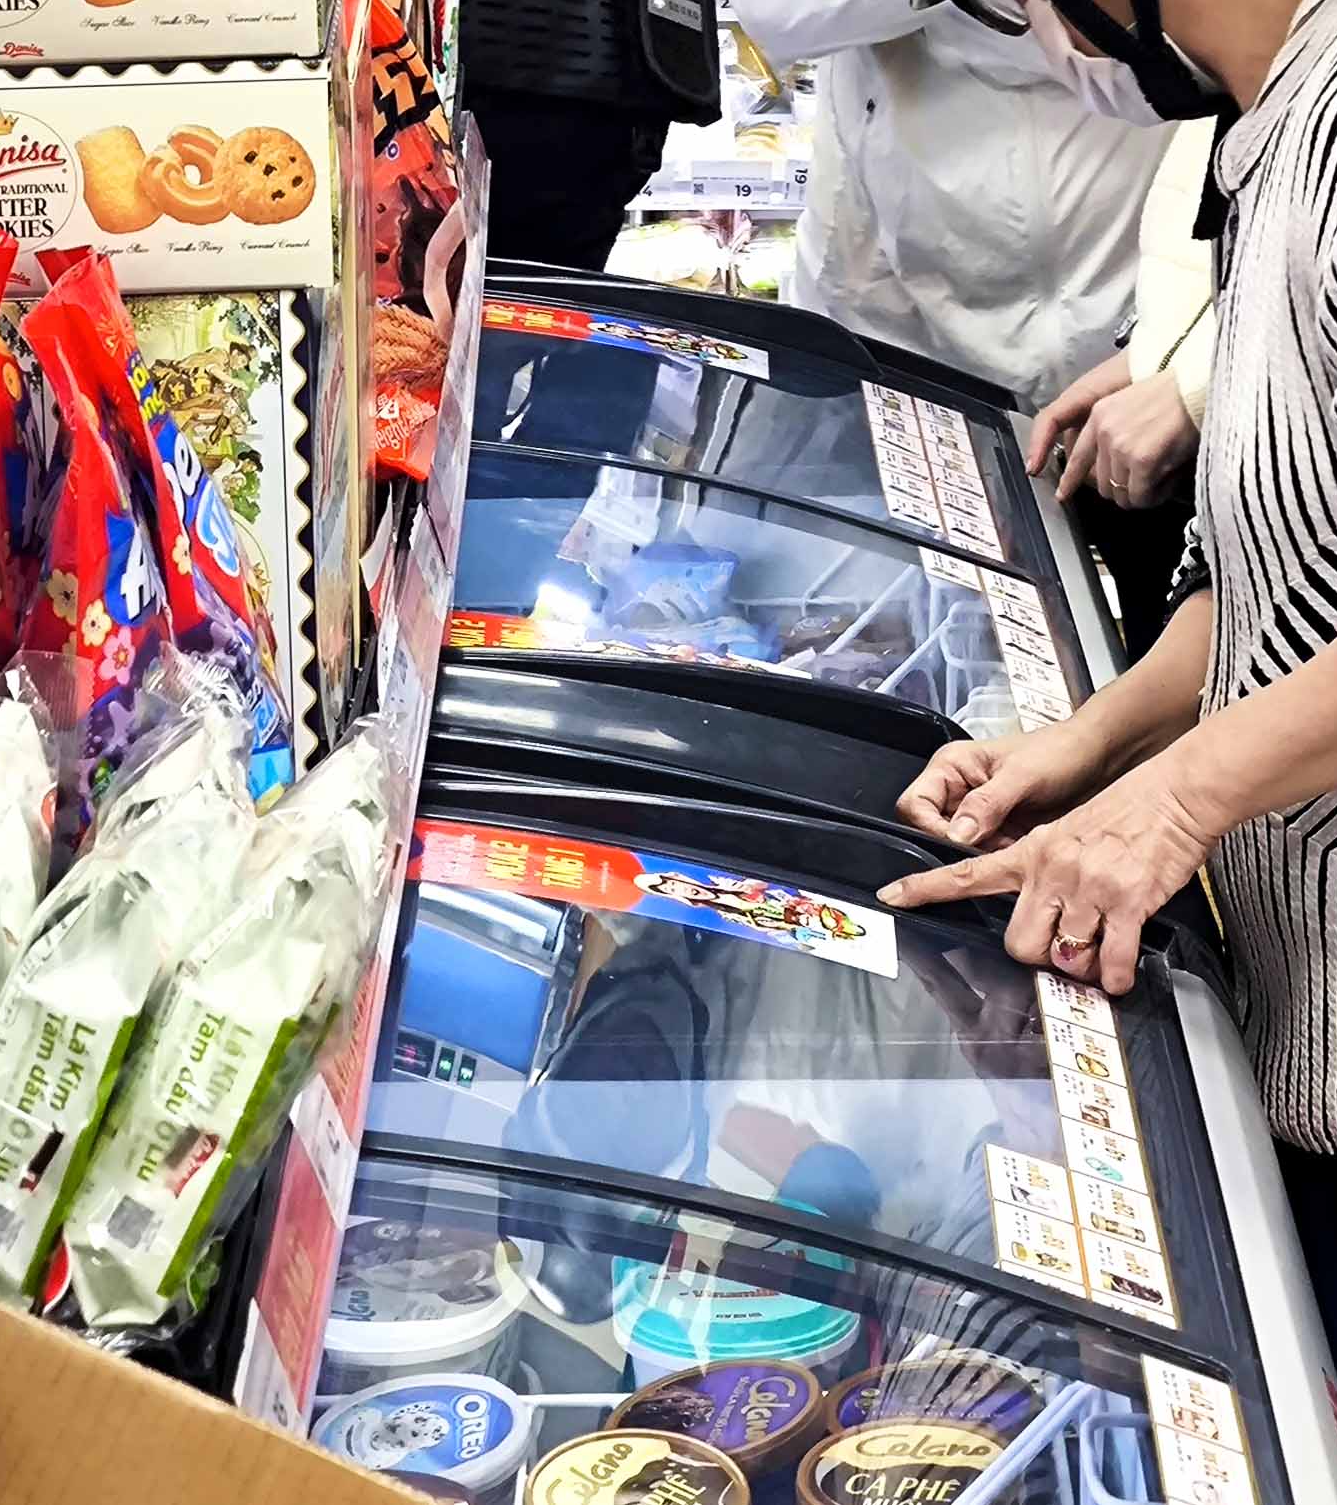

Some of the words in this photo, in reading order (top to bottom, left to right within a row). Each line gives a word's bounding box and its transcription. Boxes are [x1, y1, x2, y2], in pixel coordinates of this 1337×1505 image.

[734, 184, 752, 197] 19
[455, 1392, 485, 1461] OREO
[855, 1433, 993, 1460] Celano
